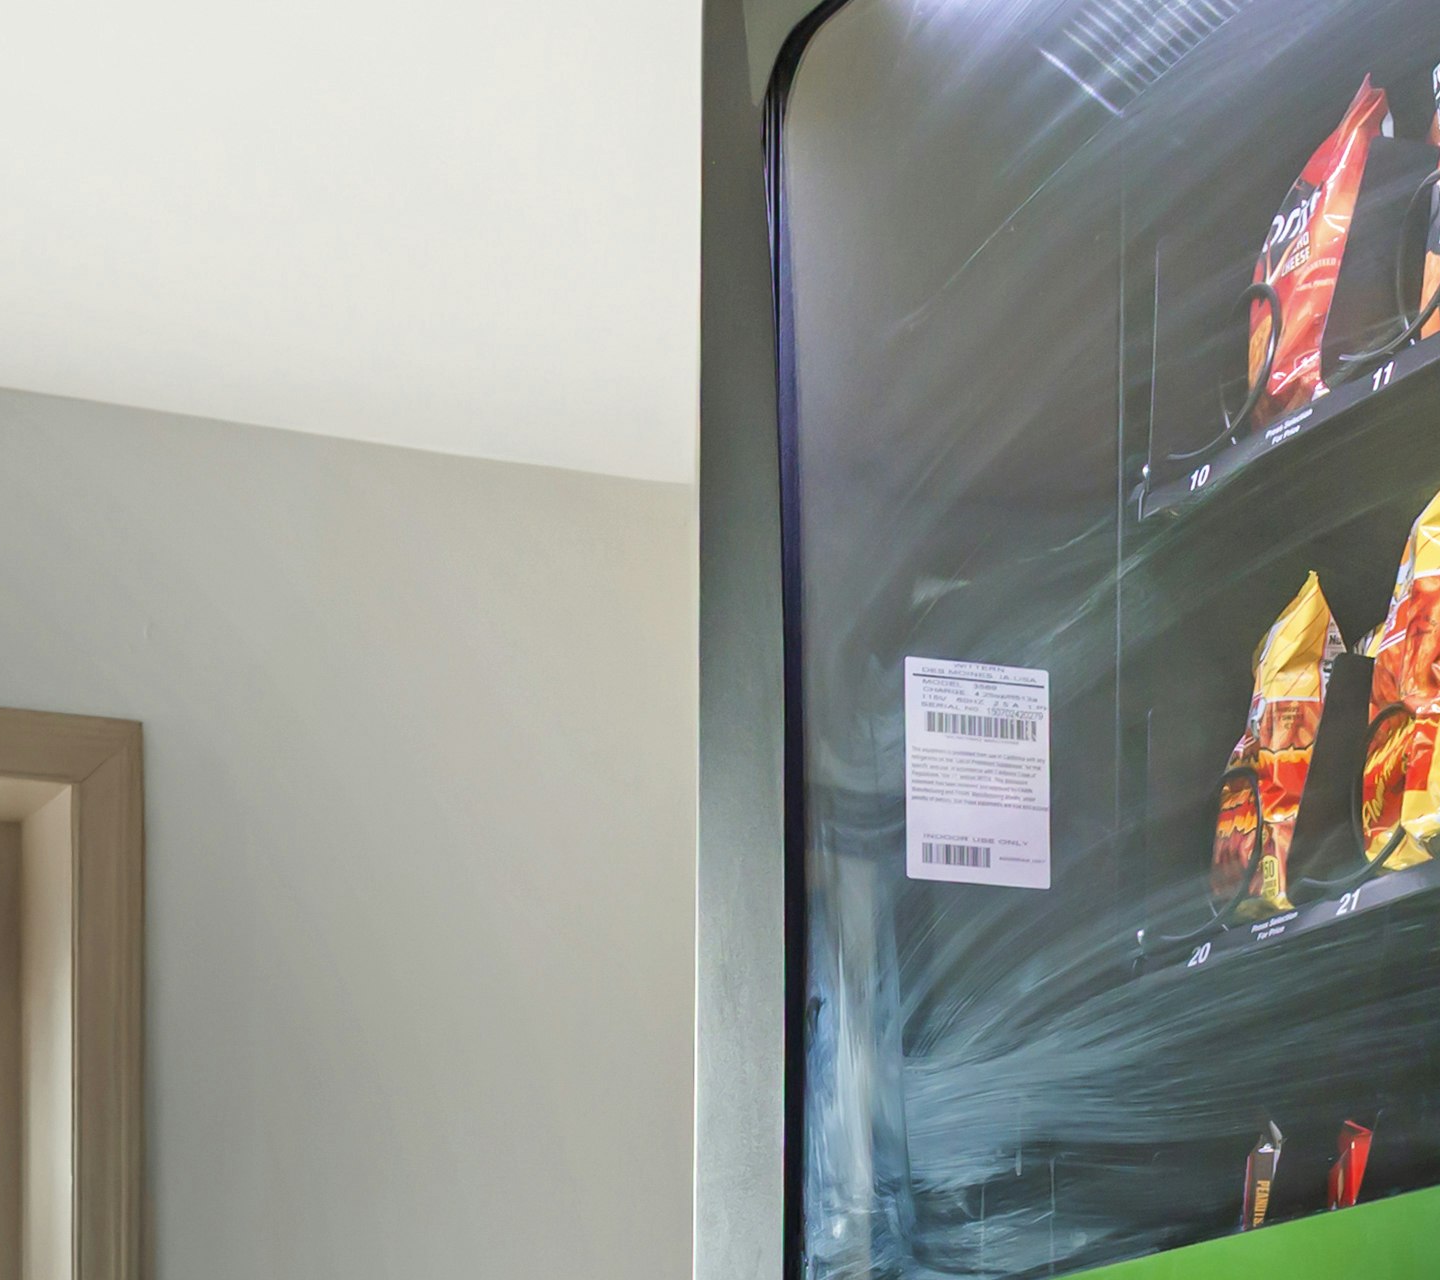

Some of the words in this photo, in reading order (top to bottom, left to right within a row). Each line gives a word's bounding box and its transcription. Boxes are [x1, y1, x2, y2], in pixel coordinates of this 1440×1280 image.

[1371, 362, 1395, 390] 11
[1188, 464, 1211, 491] 10
[1336, 890, 1361, 914] 21
[1187, 942, 1211, 967] 20
